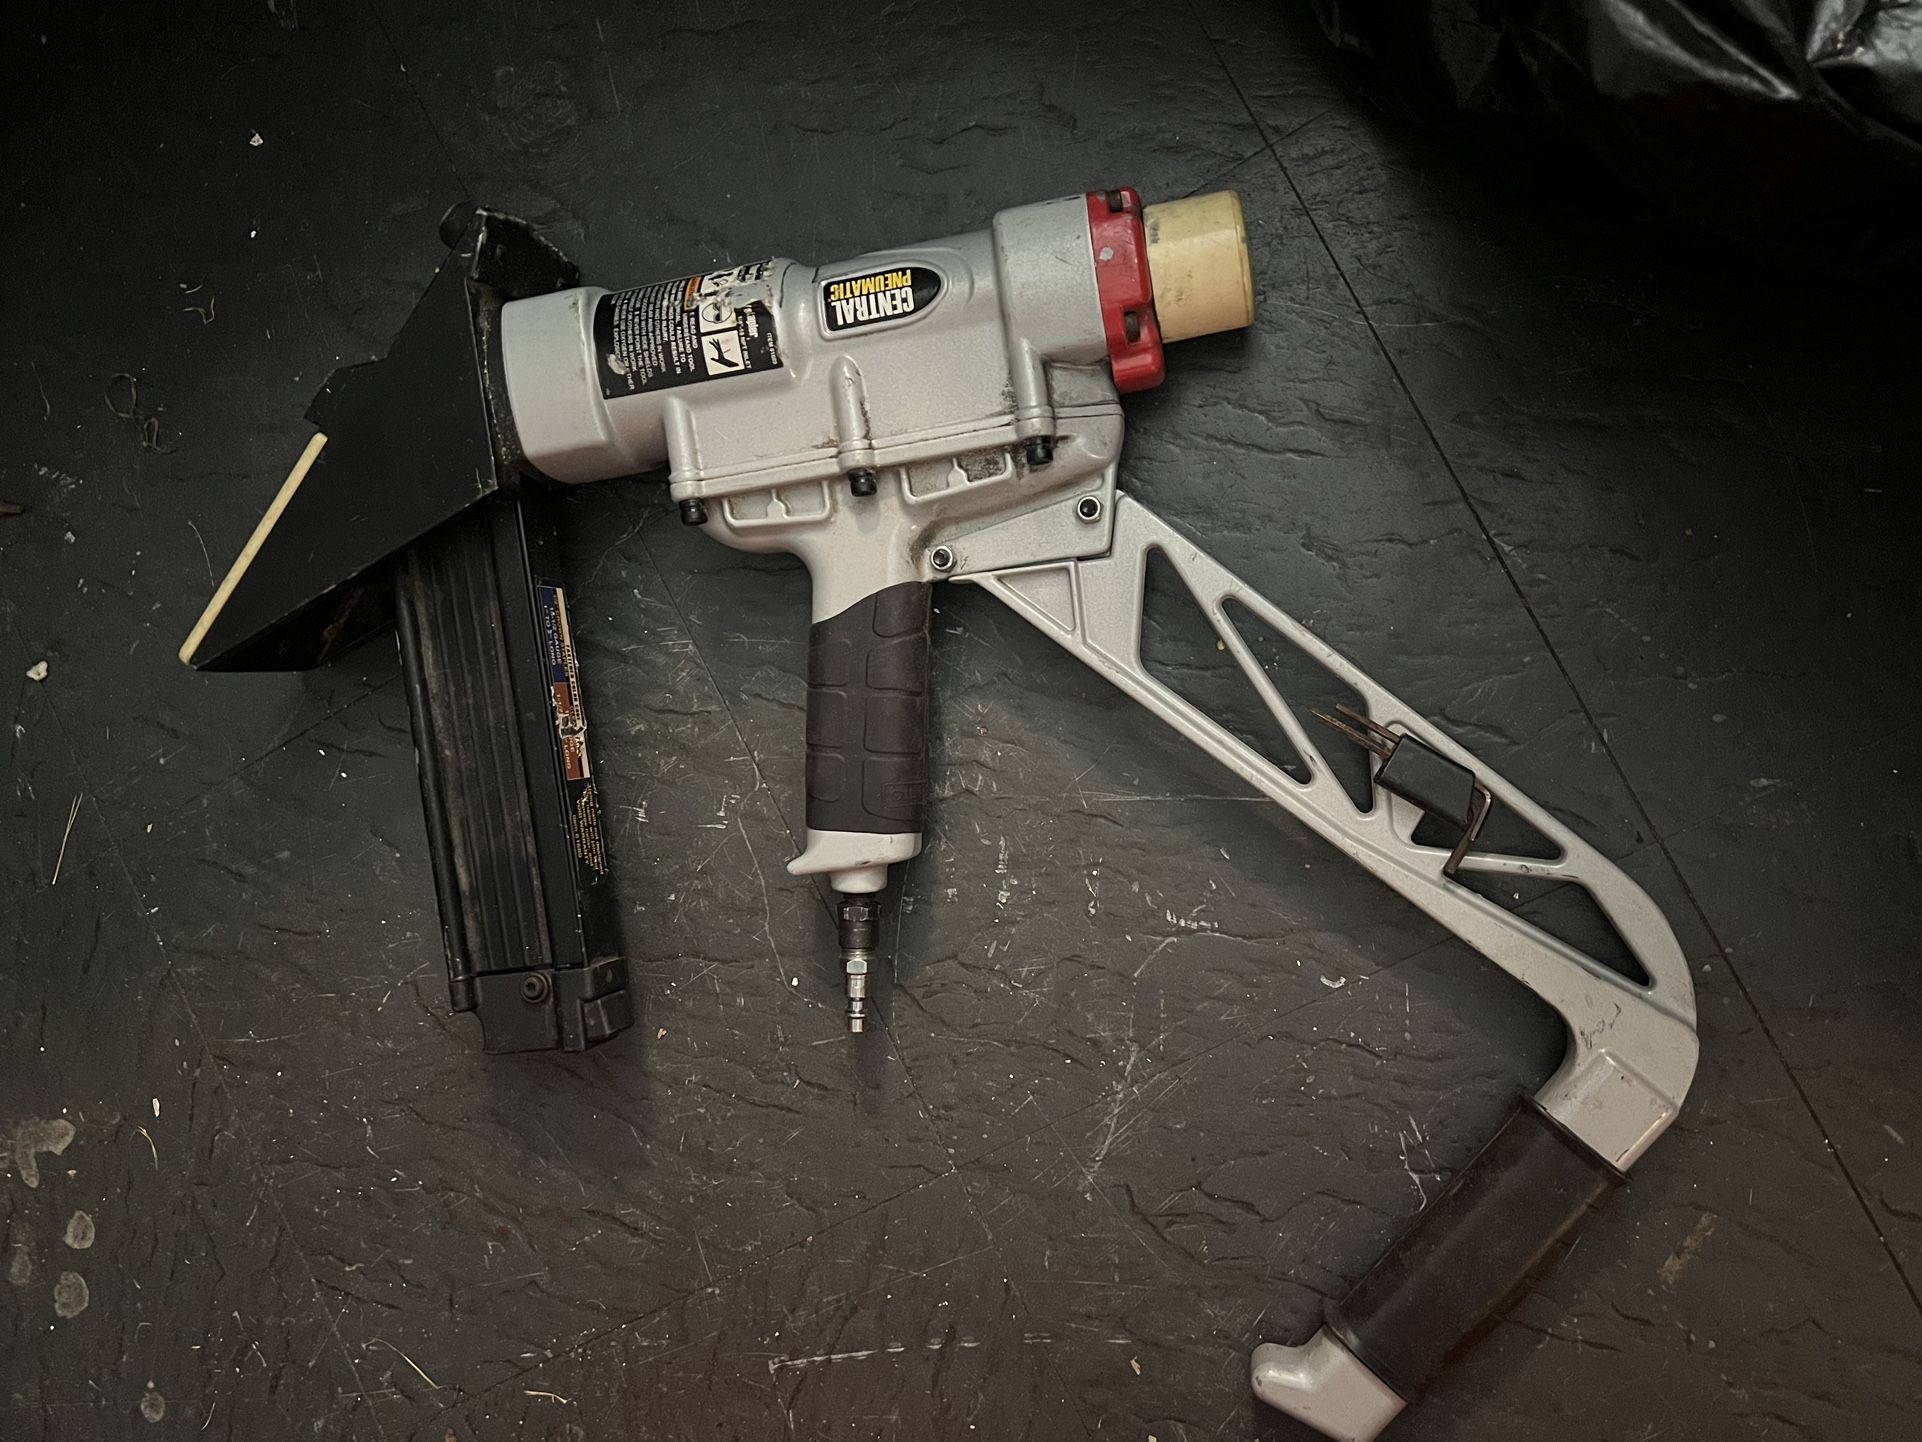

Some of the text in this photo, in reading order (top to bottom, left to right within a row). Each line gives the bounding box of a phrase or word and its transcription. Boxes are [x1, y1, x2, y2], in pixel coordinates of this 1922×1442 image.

[830, 269, 911, 300] PNEUMATIC
[831, 287, 914, 325] CENTRAL
[668, 319, 676, 341] COULD
[688, 316, 696, 334] READ
[670, 341, 679, 365] RESULT
[676, 325, 684, 352] FAILURE
[680, 353, 686, 362] TO
[690, 334, 698, 348] AND
[687, 354, 695, 372] TOOL
[639, 368, 647, 385] TOOL
[545, 616, 550, 627] TO
[548, 640, 556, 665] LONG
[553, 632, 562, 664] GAUGE
[563, 744, 571, 769] LONG
[578, 819, 589, 864] WARRANTY
